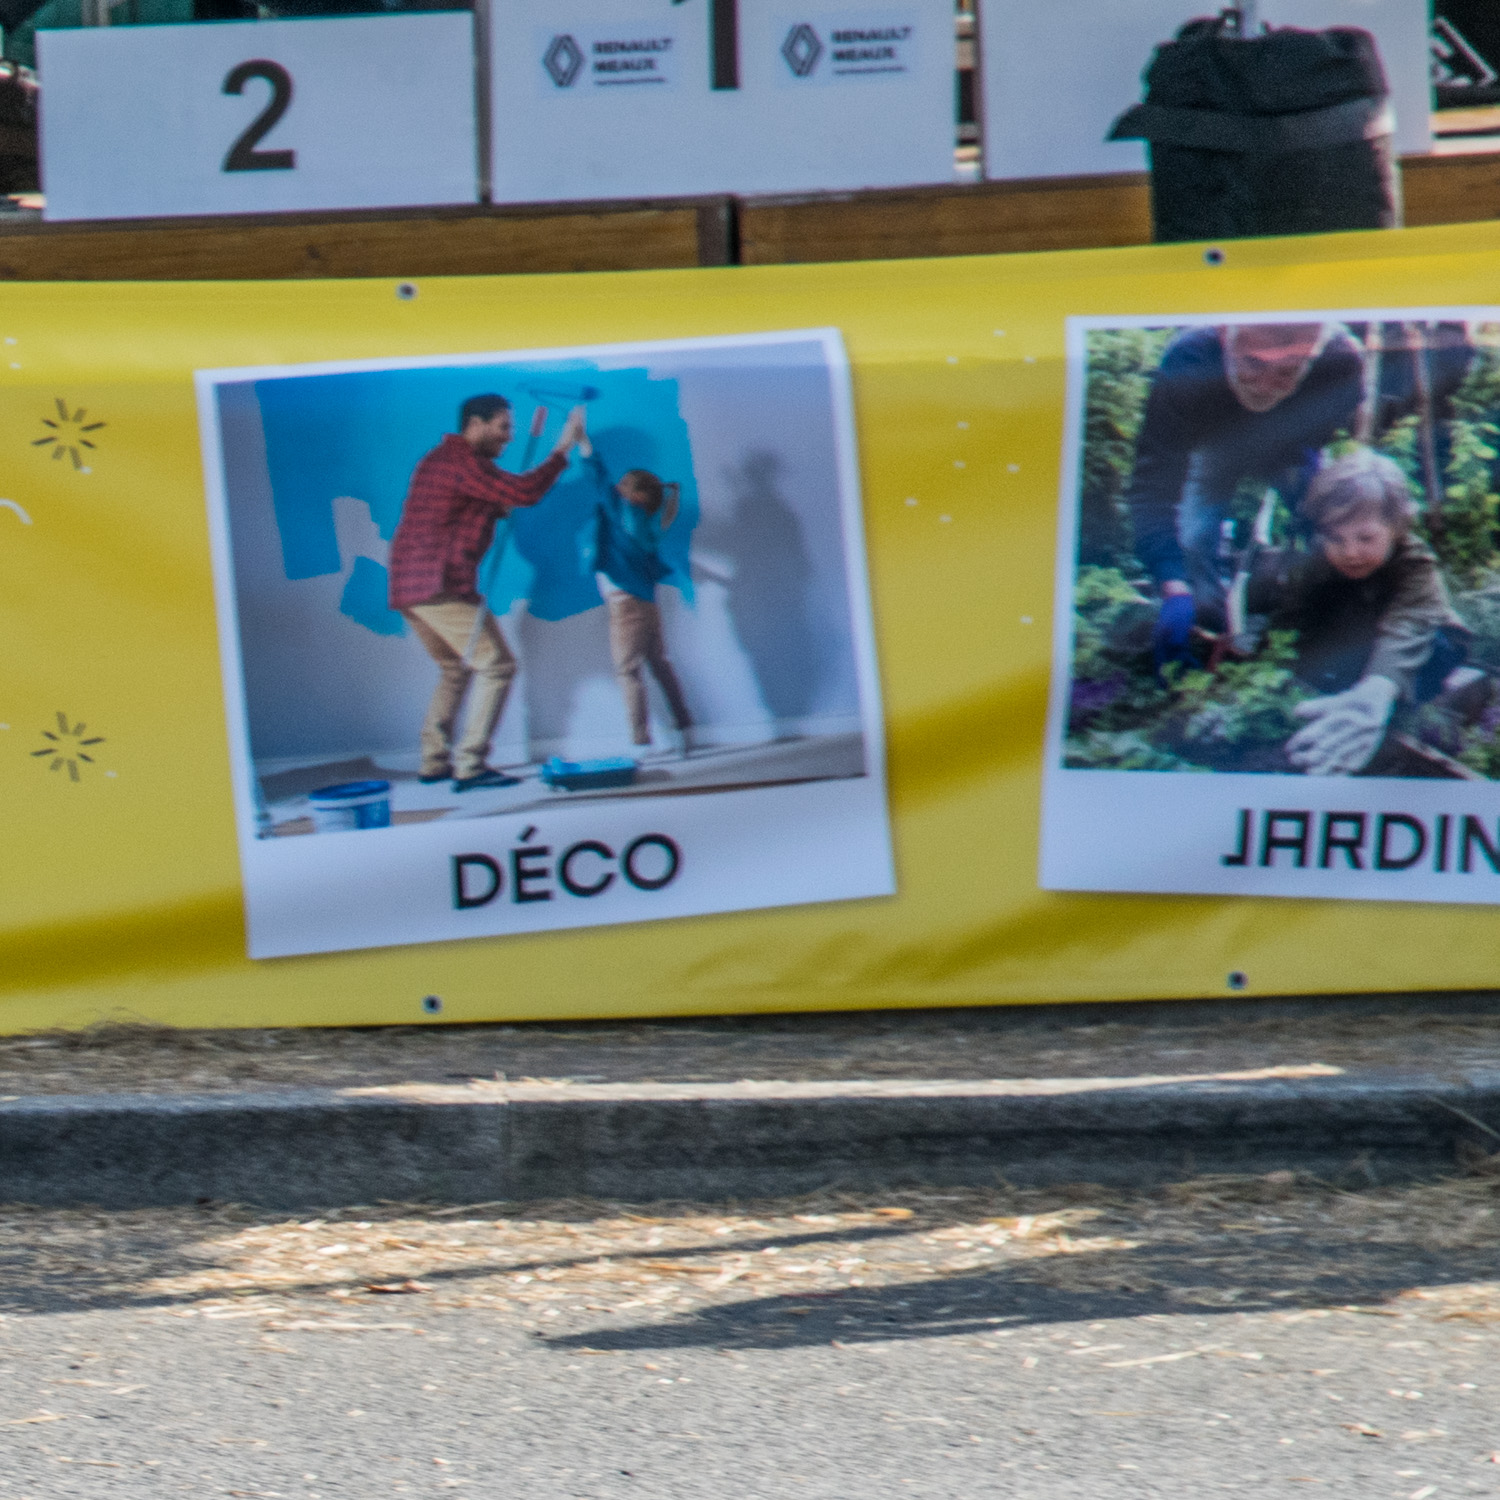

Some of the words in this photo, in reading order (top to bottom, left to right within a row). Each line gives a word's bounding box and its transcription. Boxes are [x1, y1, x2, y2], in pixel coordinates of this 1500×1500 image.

[593, 38, 674, 53] RENAULT
[670, 0, 740, 91] 1
[832, 25, 912, 42] RENAULT
[222, 59, 295, 172] 2
[452, 826, 683, 909] DÉCO
